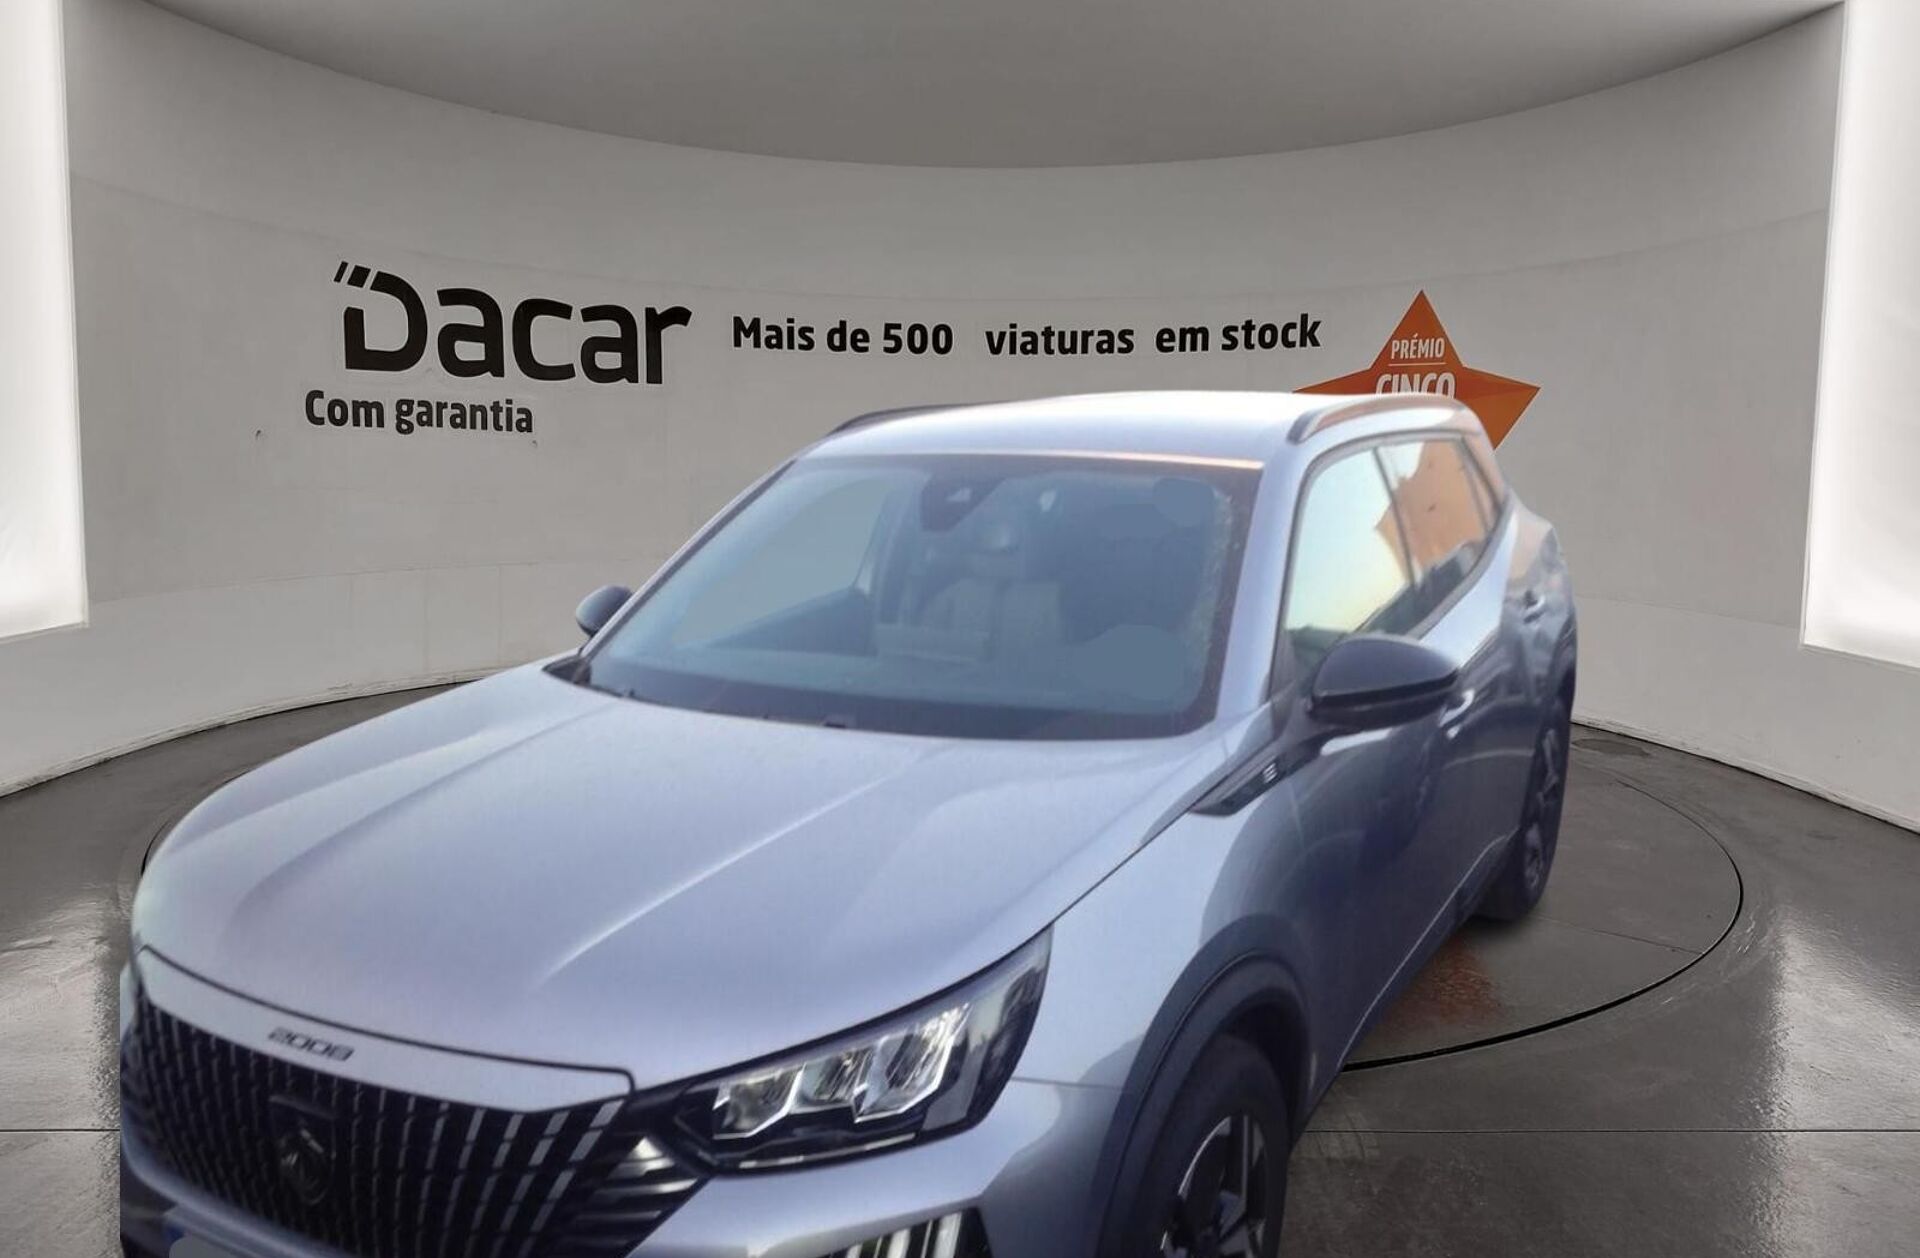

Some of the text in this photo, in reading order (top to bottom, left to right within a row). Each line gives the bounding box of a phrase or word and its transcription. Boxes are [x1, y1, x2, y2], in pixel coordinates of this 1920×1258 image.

[334, 261, 693, 385] Dacar
[732, 314, 1322, 356] Mais de 500 viaturas em stock
[1391, 333, 1446, 360] PRÉMIO
[305, 390, 533, 436] Com garantia
[267, 1026, 355, 1062] 2008
